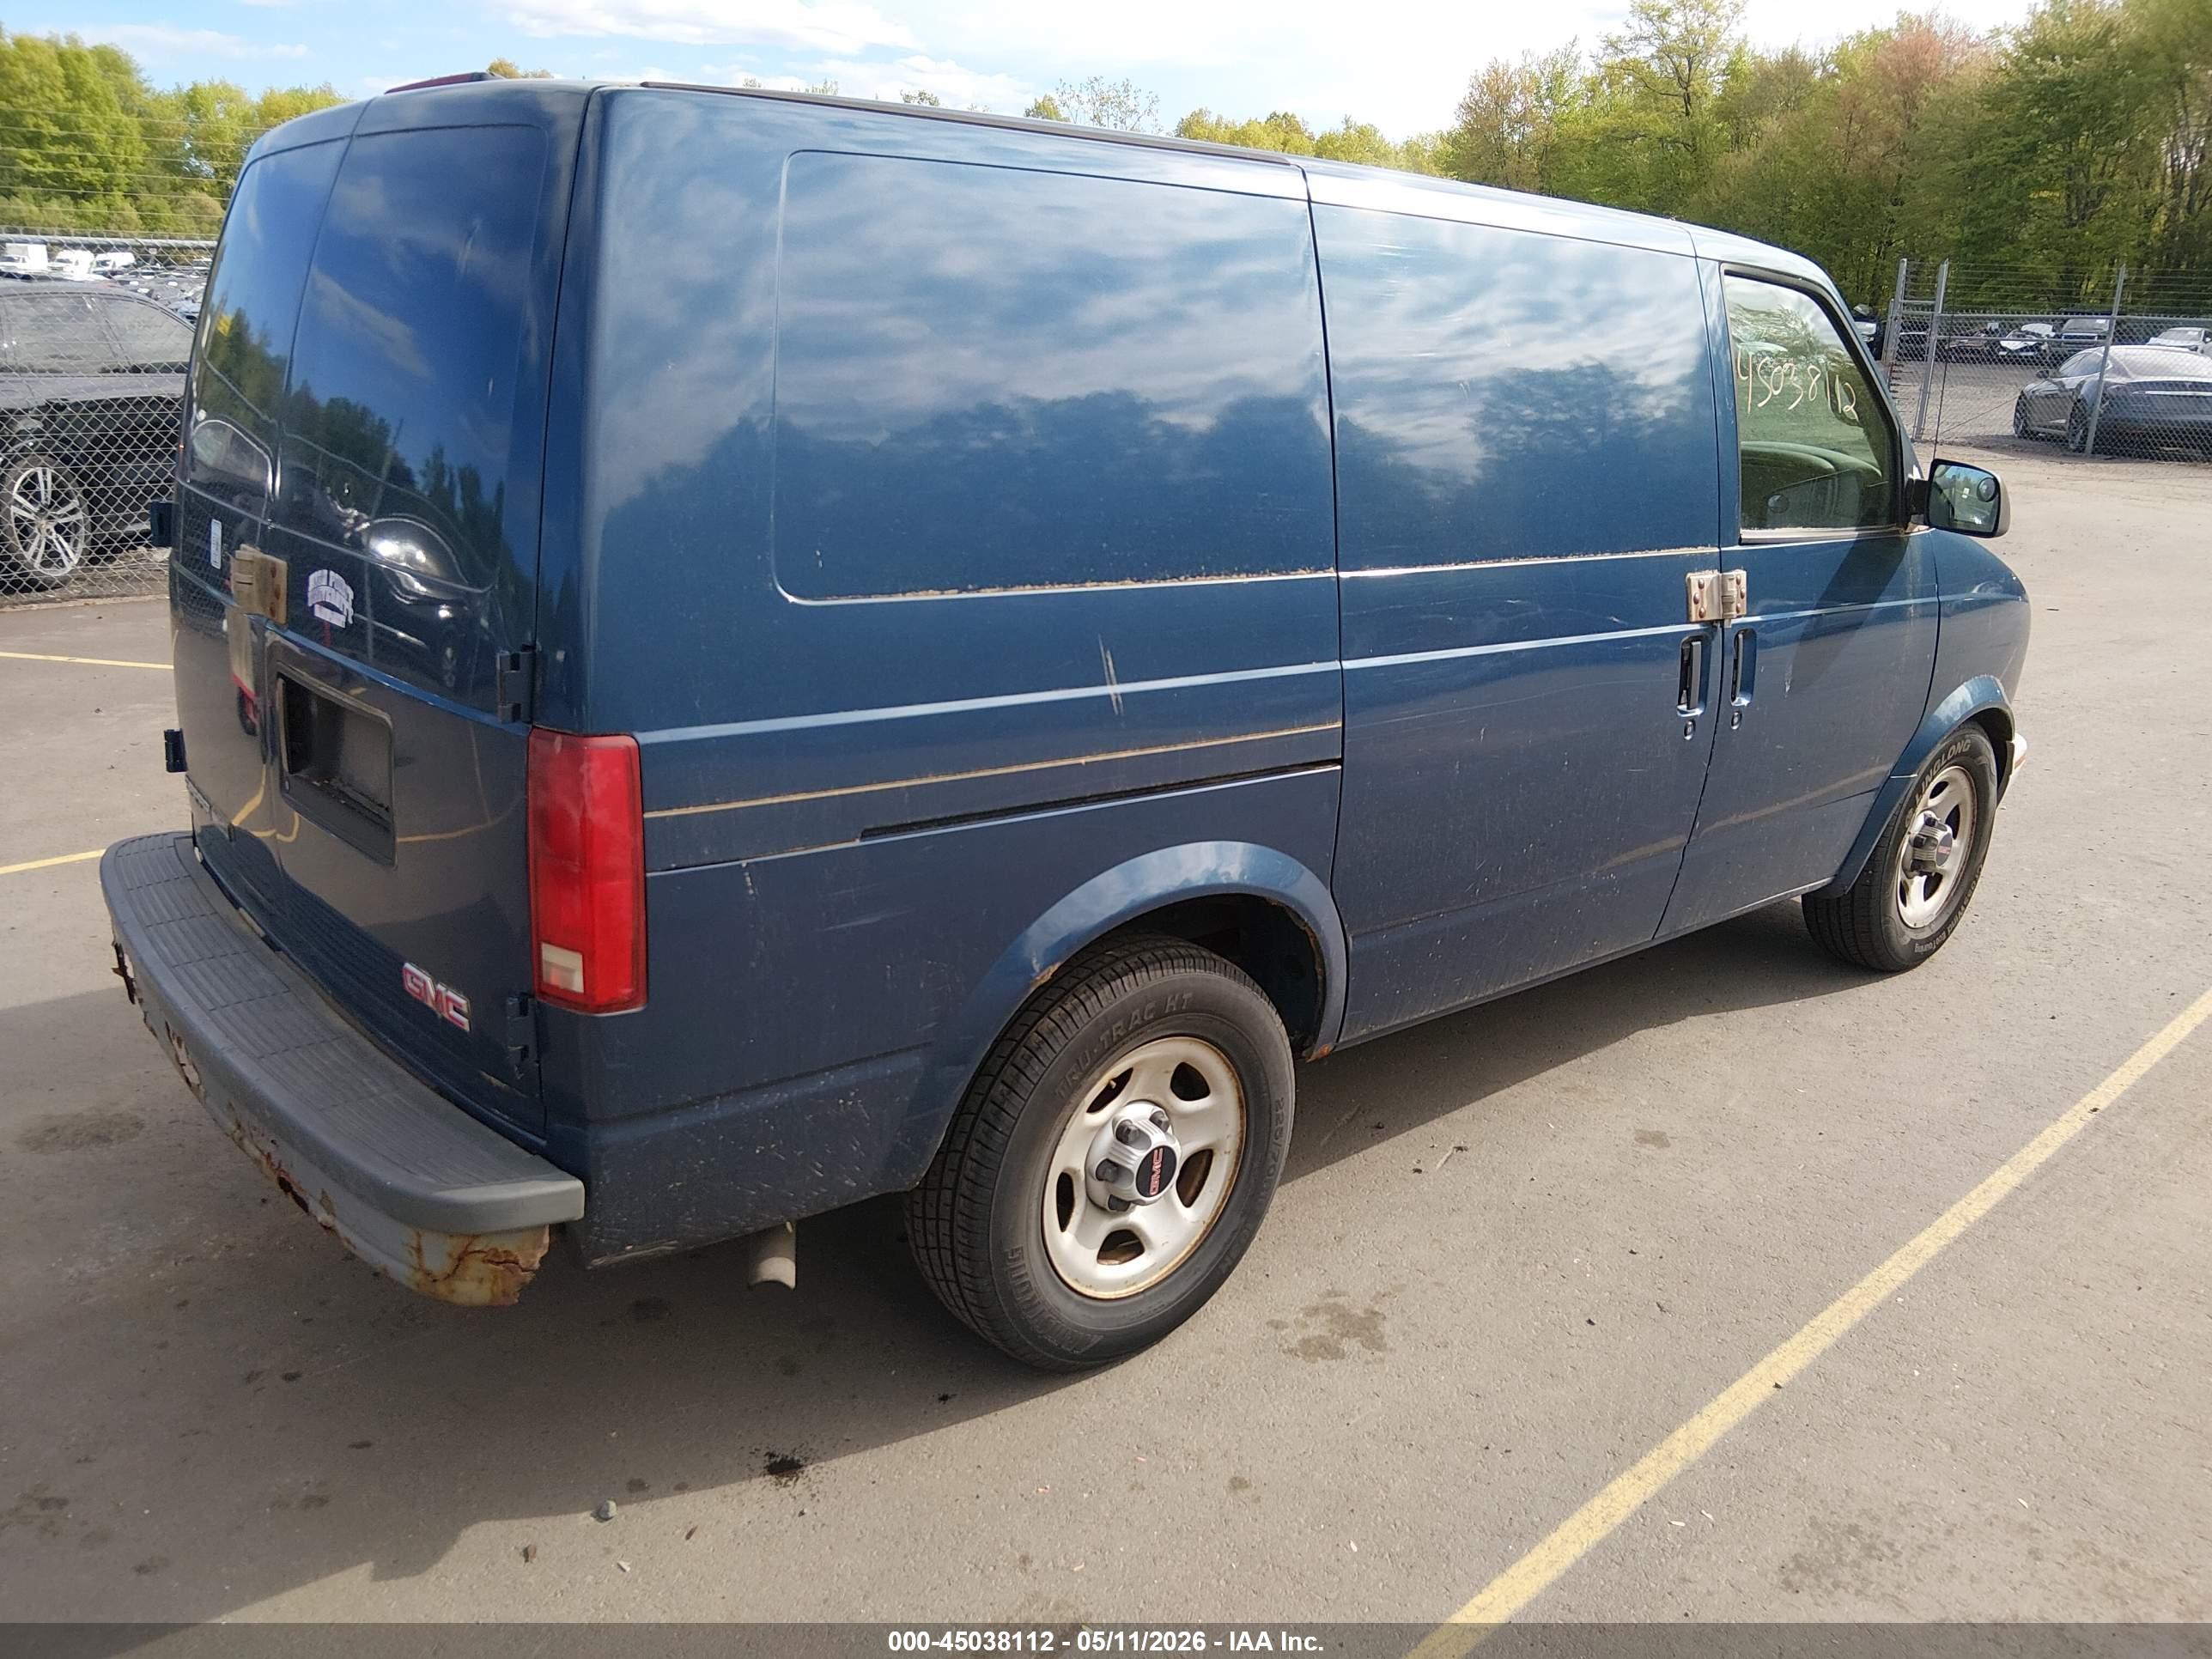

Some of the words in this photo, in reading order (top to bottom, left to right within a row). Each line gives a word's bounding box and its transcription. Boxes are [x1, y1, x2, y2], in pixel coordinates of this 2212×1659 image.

[1736, 346, 1860, 422] 45038112
[1915, 739, 1972, 805] LINGLONG
[402, 962, 471, 1032] GMC
[1164, 991, 1194, 1014] HT
[1149, 1147, 1164, 1195] GMC
